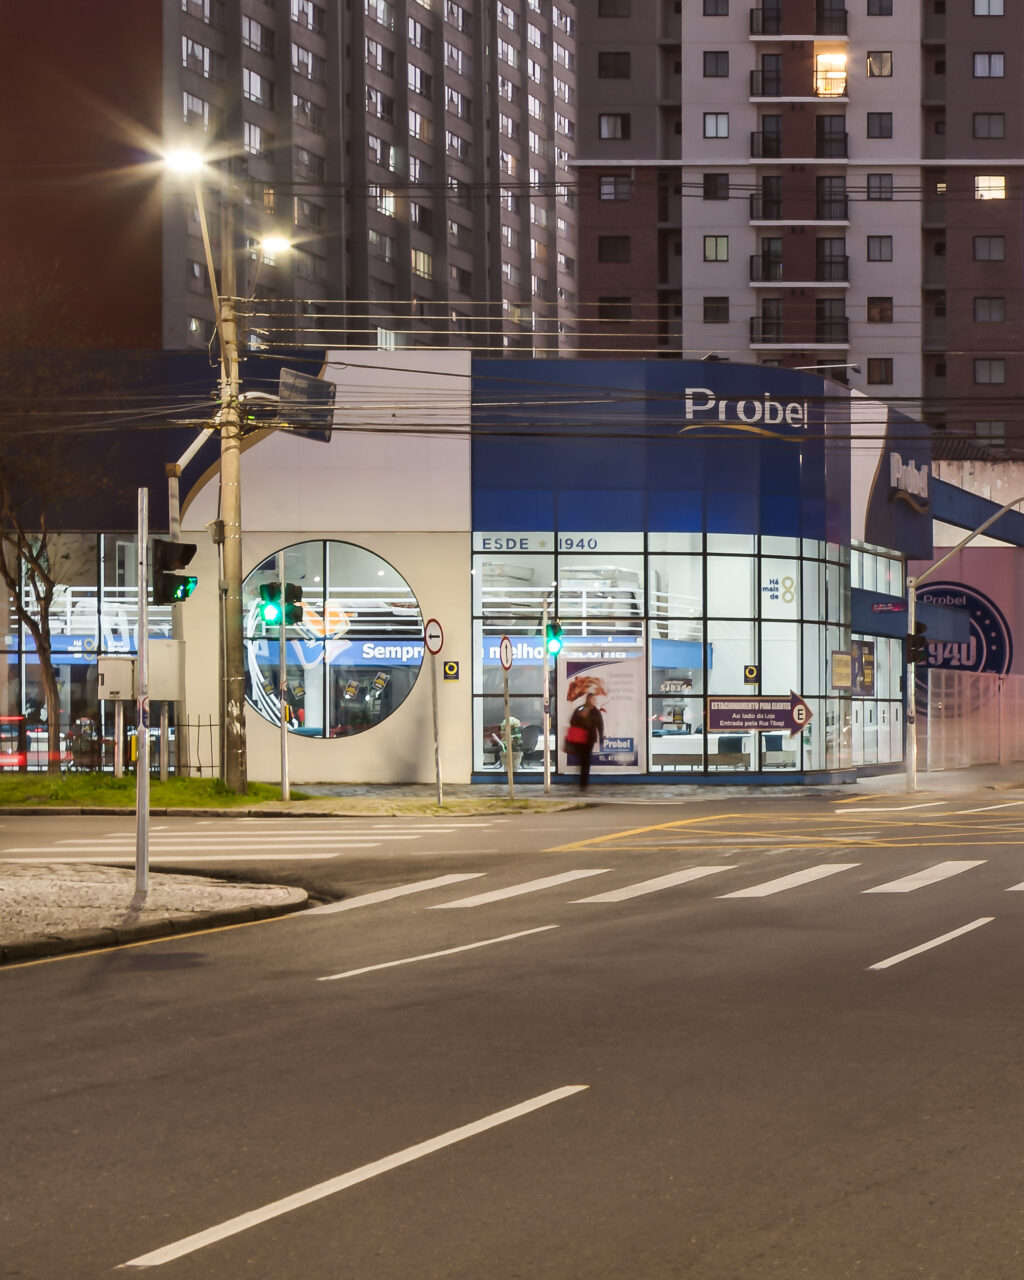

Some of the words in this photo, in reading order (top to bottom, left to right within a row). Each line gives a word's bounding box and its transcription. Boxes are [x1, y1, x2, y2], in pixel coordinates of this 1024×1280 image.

[685, 387, 808, 429] Probel
[482, 538, 529, 550] ESDE
[558, 538, 598, 550] 1940
[923, 594, 967, 606] Probel
[916, 635, 977, 666] 940
[797, 708, 804, 720] E
[603, 740, 631, 749] Probel
